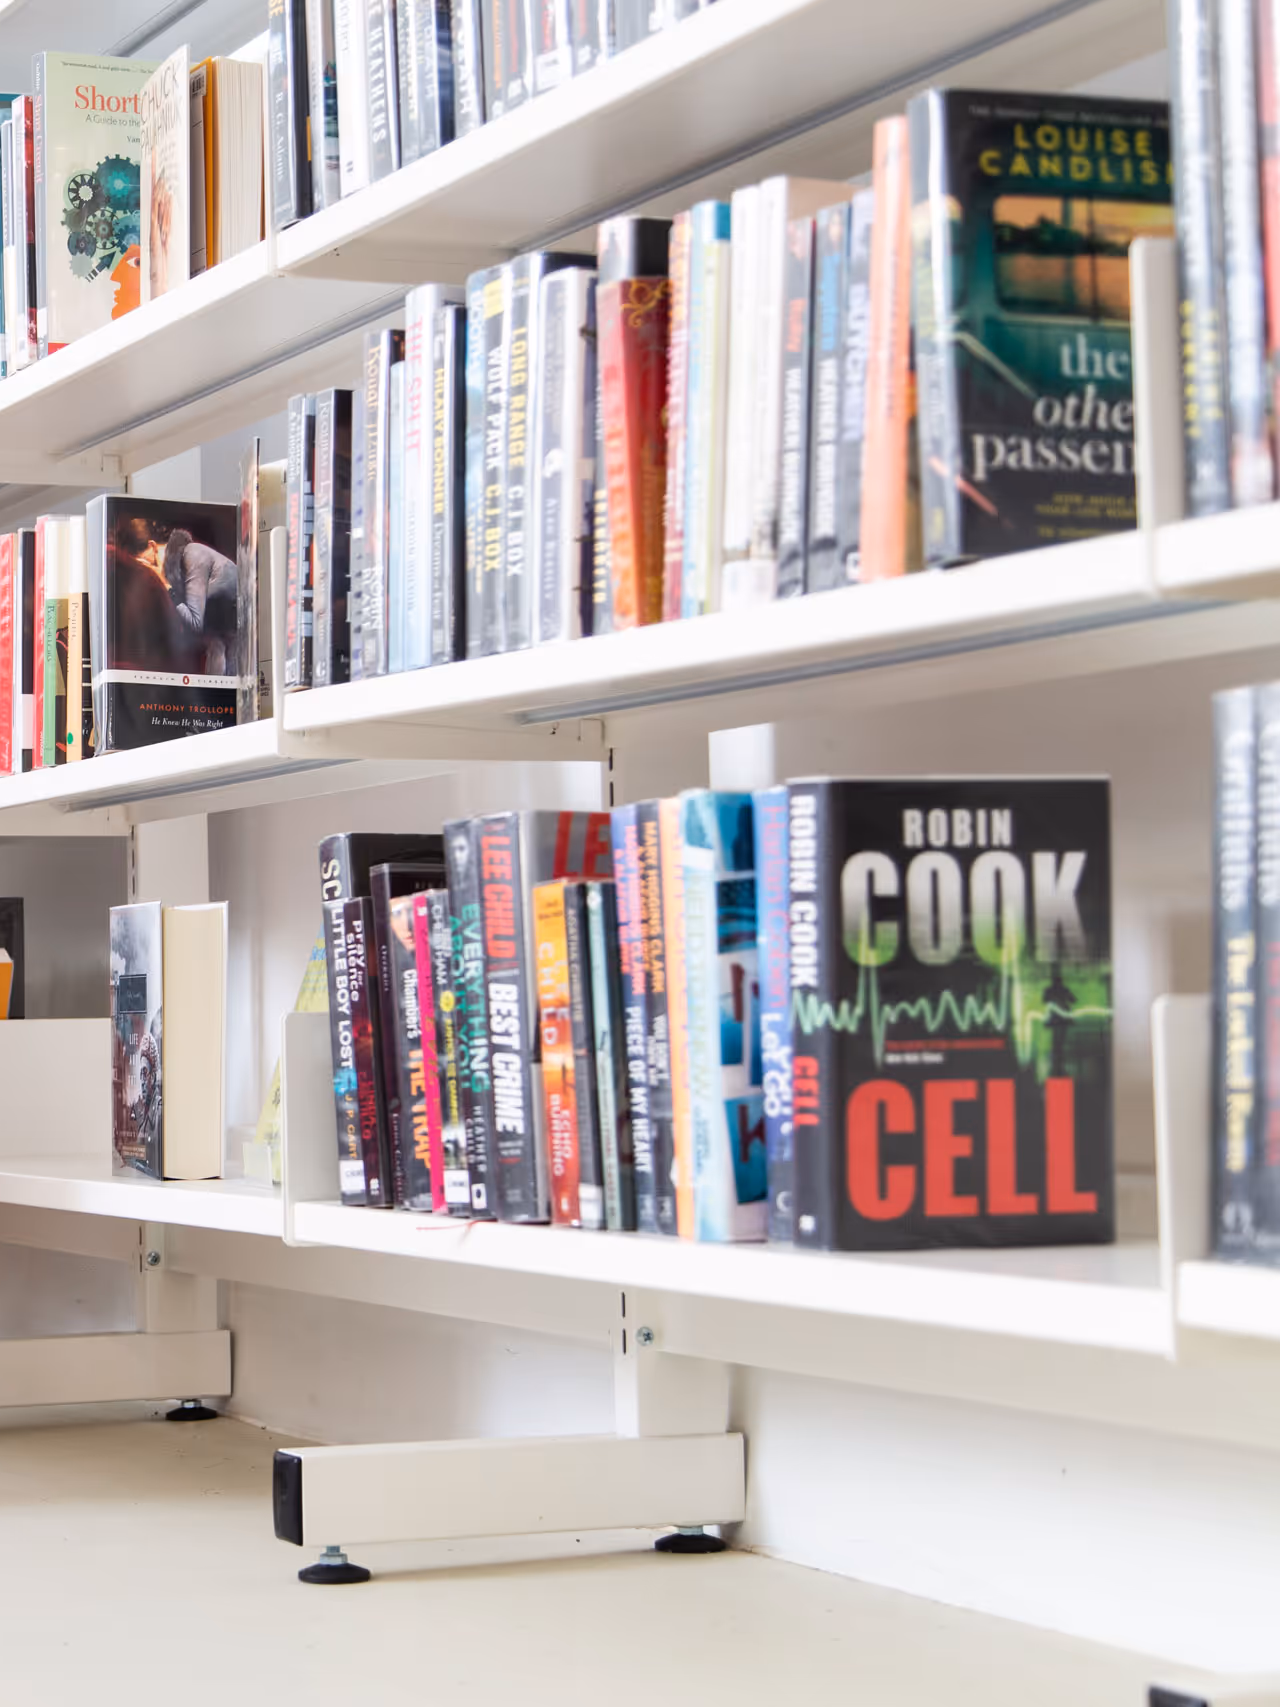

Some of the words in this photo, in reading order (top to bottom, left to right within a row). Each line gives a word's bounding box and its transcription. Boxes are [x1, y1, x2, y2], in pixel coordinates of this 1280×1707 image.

[74, 85, 141, 115] Short
[94, 115, 118, 126] Guide
[119, 118, 128, 126] to
[1014, 123, 1153, 157] LOUISE
[486, 344, 506, 406] WOLF
[510, 326, 528, 387] LONG
[1060, 332, 1130, 380] the
[486, 411, 505, 472] PACK
[508, 394, 527, 470] RANGE
[433, 437, 445, 514] BONNER
[484, 527, 502, 572] BOX
[506, 530, 525, 577] BOX
[139, 703, 185, 713] ANTHONY
[189, 706, 235, 715] TROLLOPE
[151, 716, 161, 725] He
[162, 717, 180, 726] Knew
[181, 718, 191, 727] He
[192, 718, 206, 727] Was
[206, 719, 224, 729] Right
[642, 821, 658, 865] MARY
[789, 794, 818, 894] ROBIN
[902, 808, 1013, 847] ROBIN
[320, 858, 342, 900] SC
[480, 835, 512, 880] LEE
[483, 883, 516, 959] CHILD
[840, 850, 1088, 967] COOK
[330, 908, 349, 972] LITTLE
[346, 932, 360, 1001] silence
[352, 920, 366, 967] pray
[789, 900, 819, 988] COOK
[335, 974, 351, 1013] BOY
[461, 903, 490, 1093] EVERYTHING
[488, 981, 521, 1050] BEST
[538, 941, 558, 1045] CHILD
[338, 1020, 354, 1069] LOST
[624, 1006, 644, 1056] PIECE
[491, 1051, 525, 1135] CRIME
[627, 1059, 647, 1084] OF
[793, 1055, 820, 1129] CELL
[629, 1086, 649, 1116] MY
[411, 1104, 431, 1169] TRAP
[632, 1118, 653, 1173] HEART
[846, 1077, 1098, 1221] CELL
